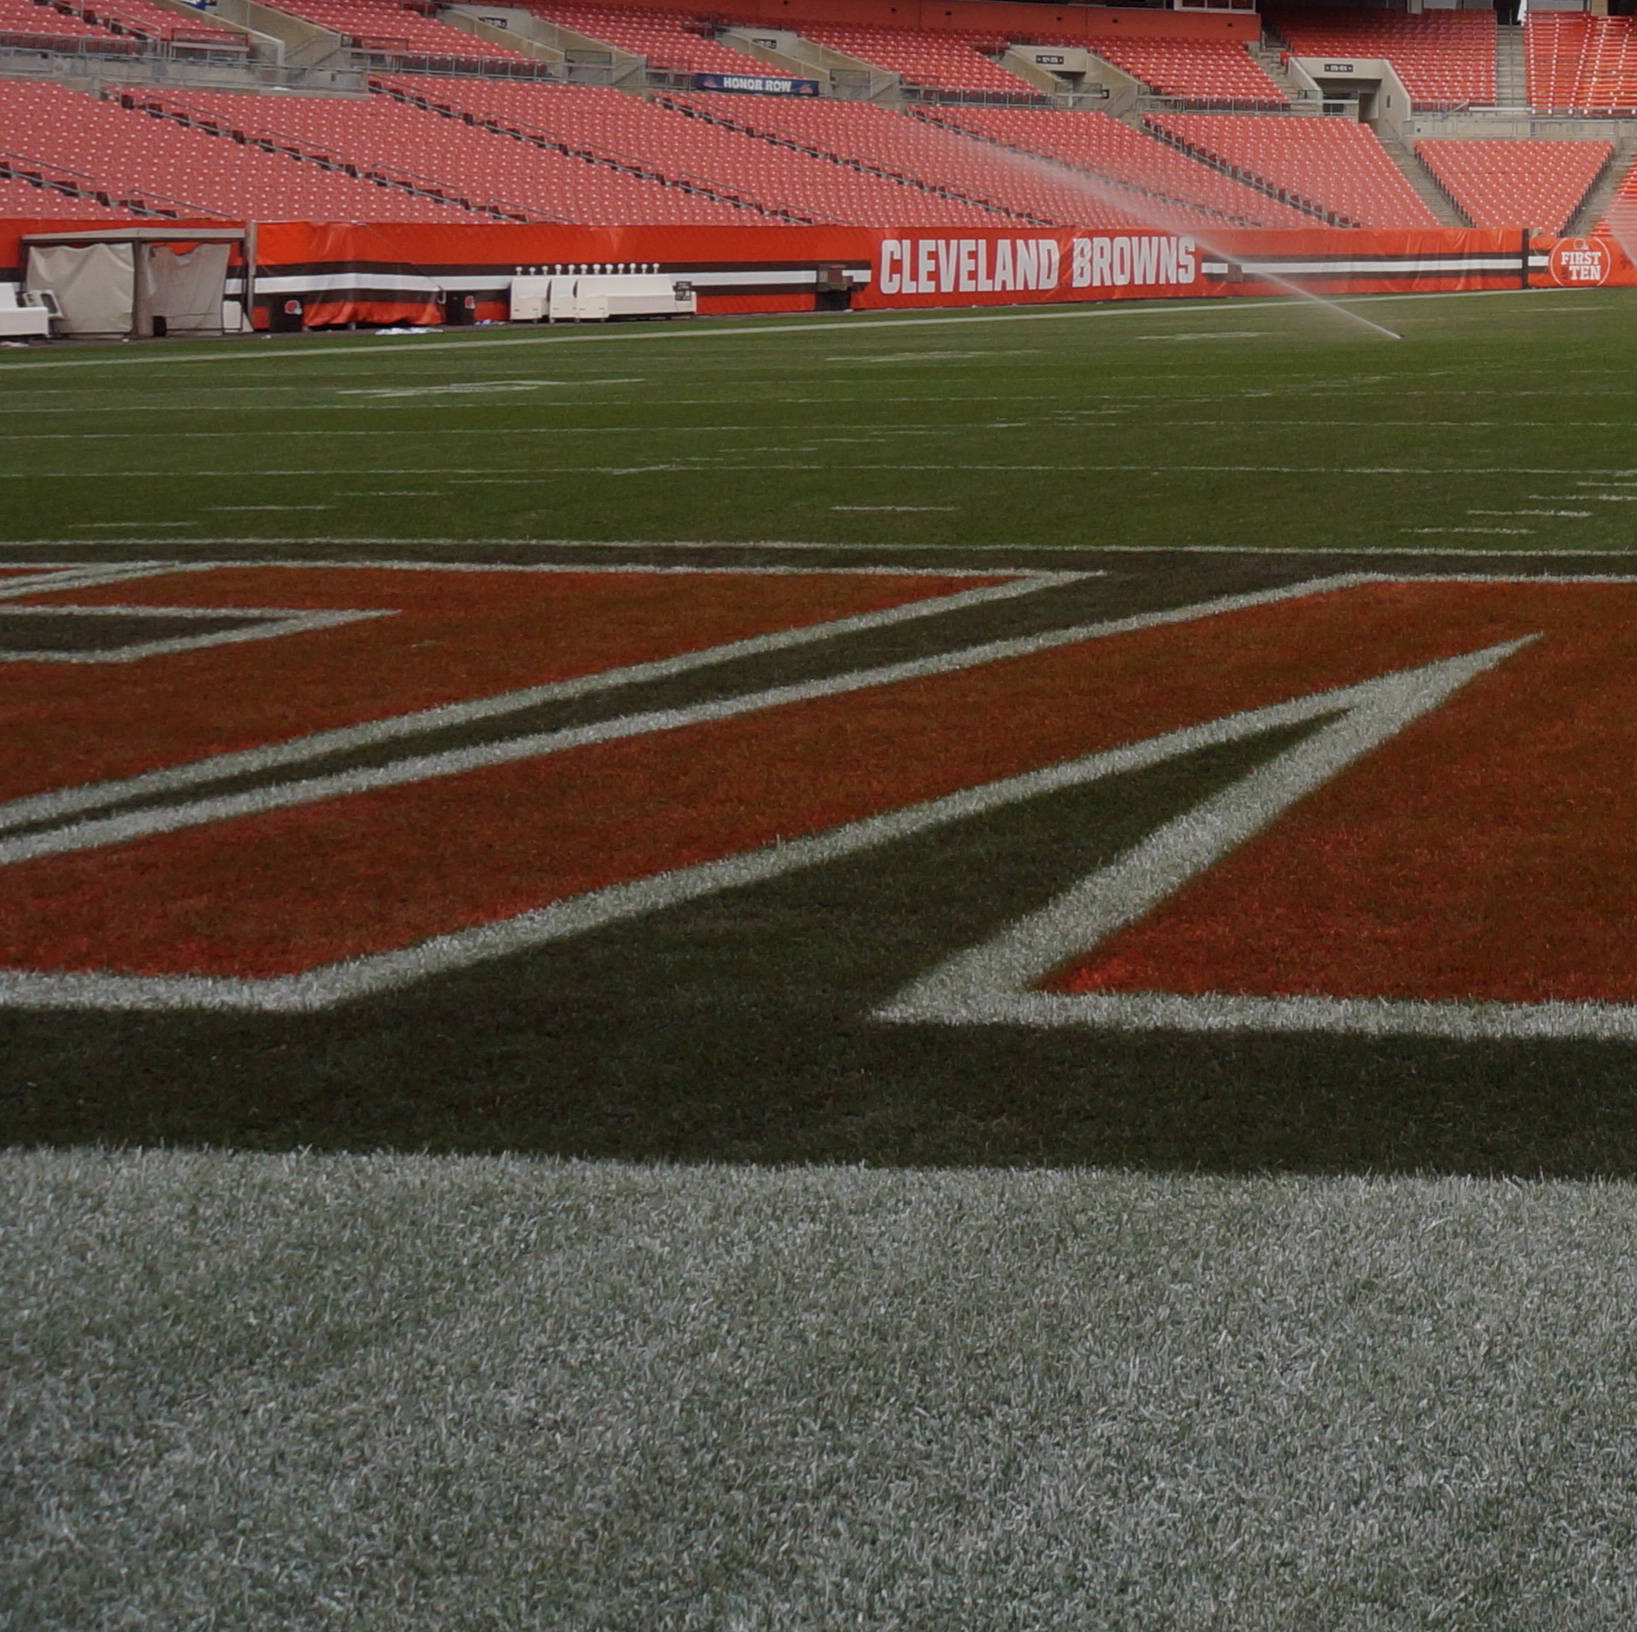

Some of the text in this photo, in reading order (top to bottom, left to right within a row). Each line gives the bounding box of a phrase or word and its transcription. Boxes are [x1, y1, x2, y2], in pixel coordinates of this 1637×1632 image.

[723, 77, 792, 93] HONOR ROW
[880, 236, 1196, 294] CLEVELAND BROWNS
[1560, 251, 1601, 265] FIRST
[1568, 266, 1601, 280] TEN
